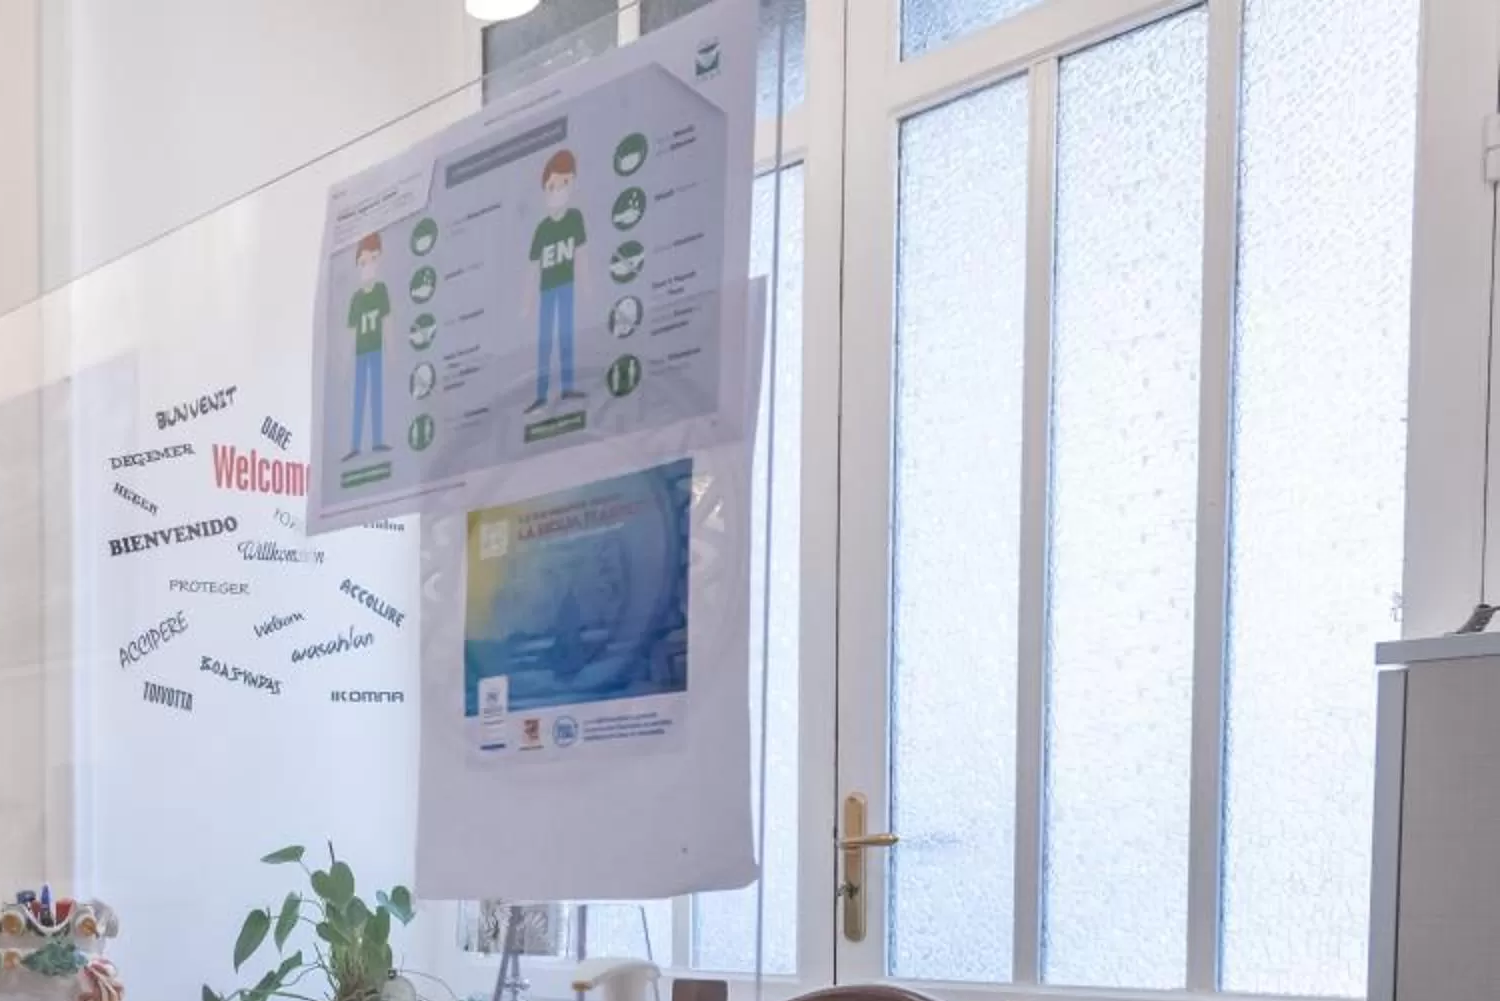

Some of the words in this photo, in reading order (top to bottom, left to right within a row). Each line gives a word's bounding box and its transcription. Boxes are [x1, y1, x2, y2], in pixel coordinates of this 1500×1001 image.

[542, 237, 575, 270] EN
[360, 308, 379, 333] IT
[211, 443, 312, 497] Welcom
[109, 516, 239, 557] BIENVENIDO
[237, 540, 326, 565] Willkomn
[169, 578, 250, 596] PROTEGER
